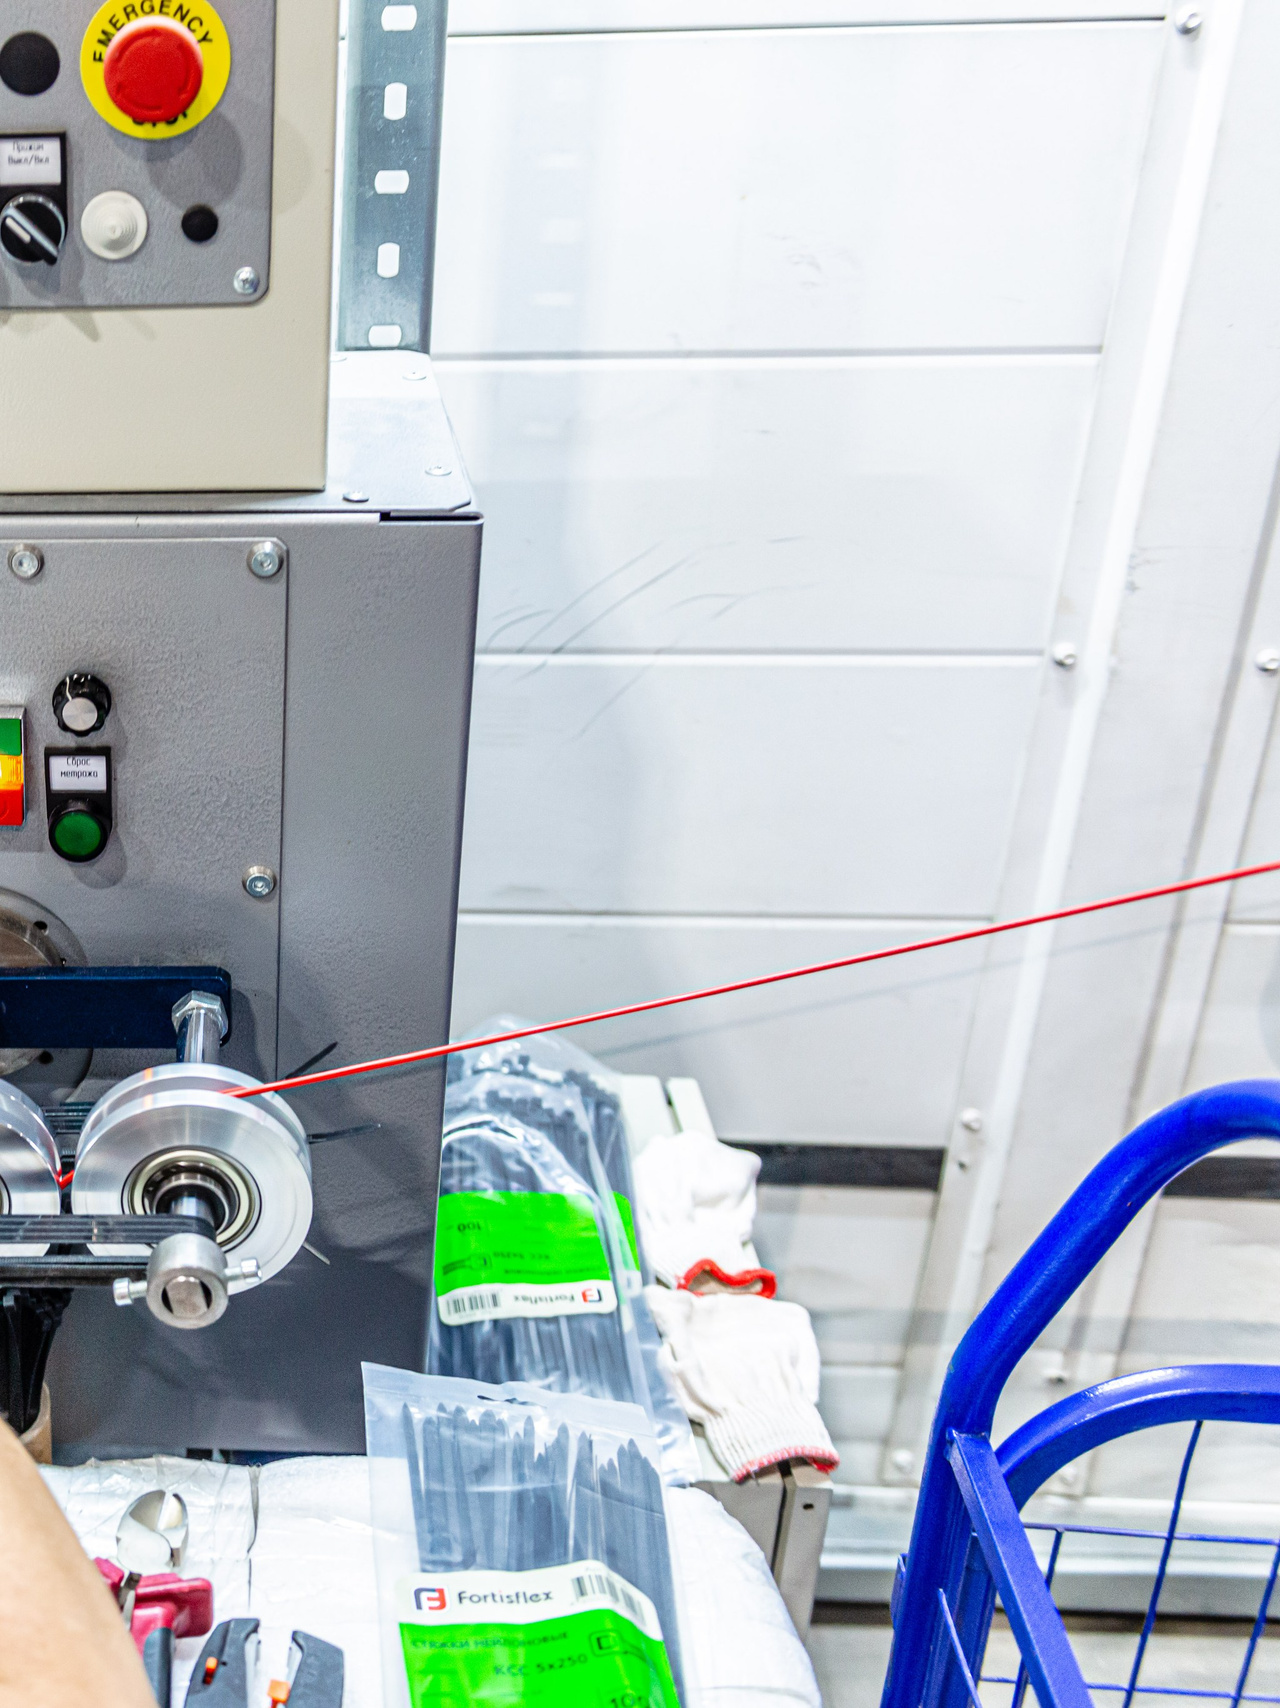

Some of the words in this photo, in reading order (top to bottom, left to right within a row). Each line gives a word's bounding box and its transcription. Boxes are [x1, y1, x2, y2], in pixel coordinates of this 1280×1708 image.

[92, 0, 214, 64] EMERGENCY
[66, 756, 91, 767] Сброс
[60, 769, 98, 780] метража
[513, 1293, 576, 1306] Fortisflex
[457, 1589, 554, 1605] Fortisflex
[411, 1638, 471, 1650] СТЯЖКИ
